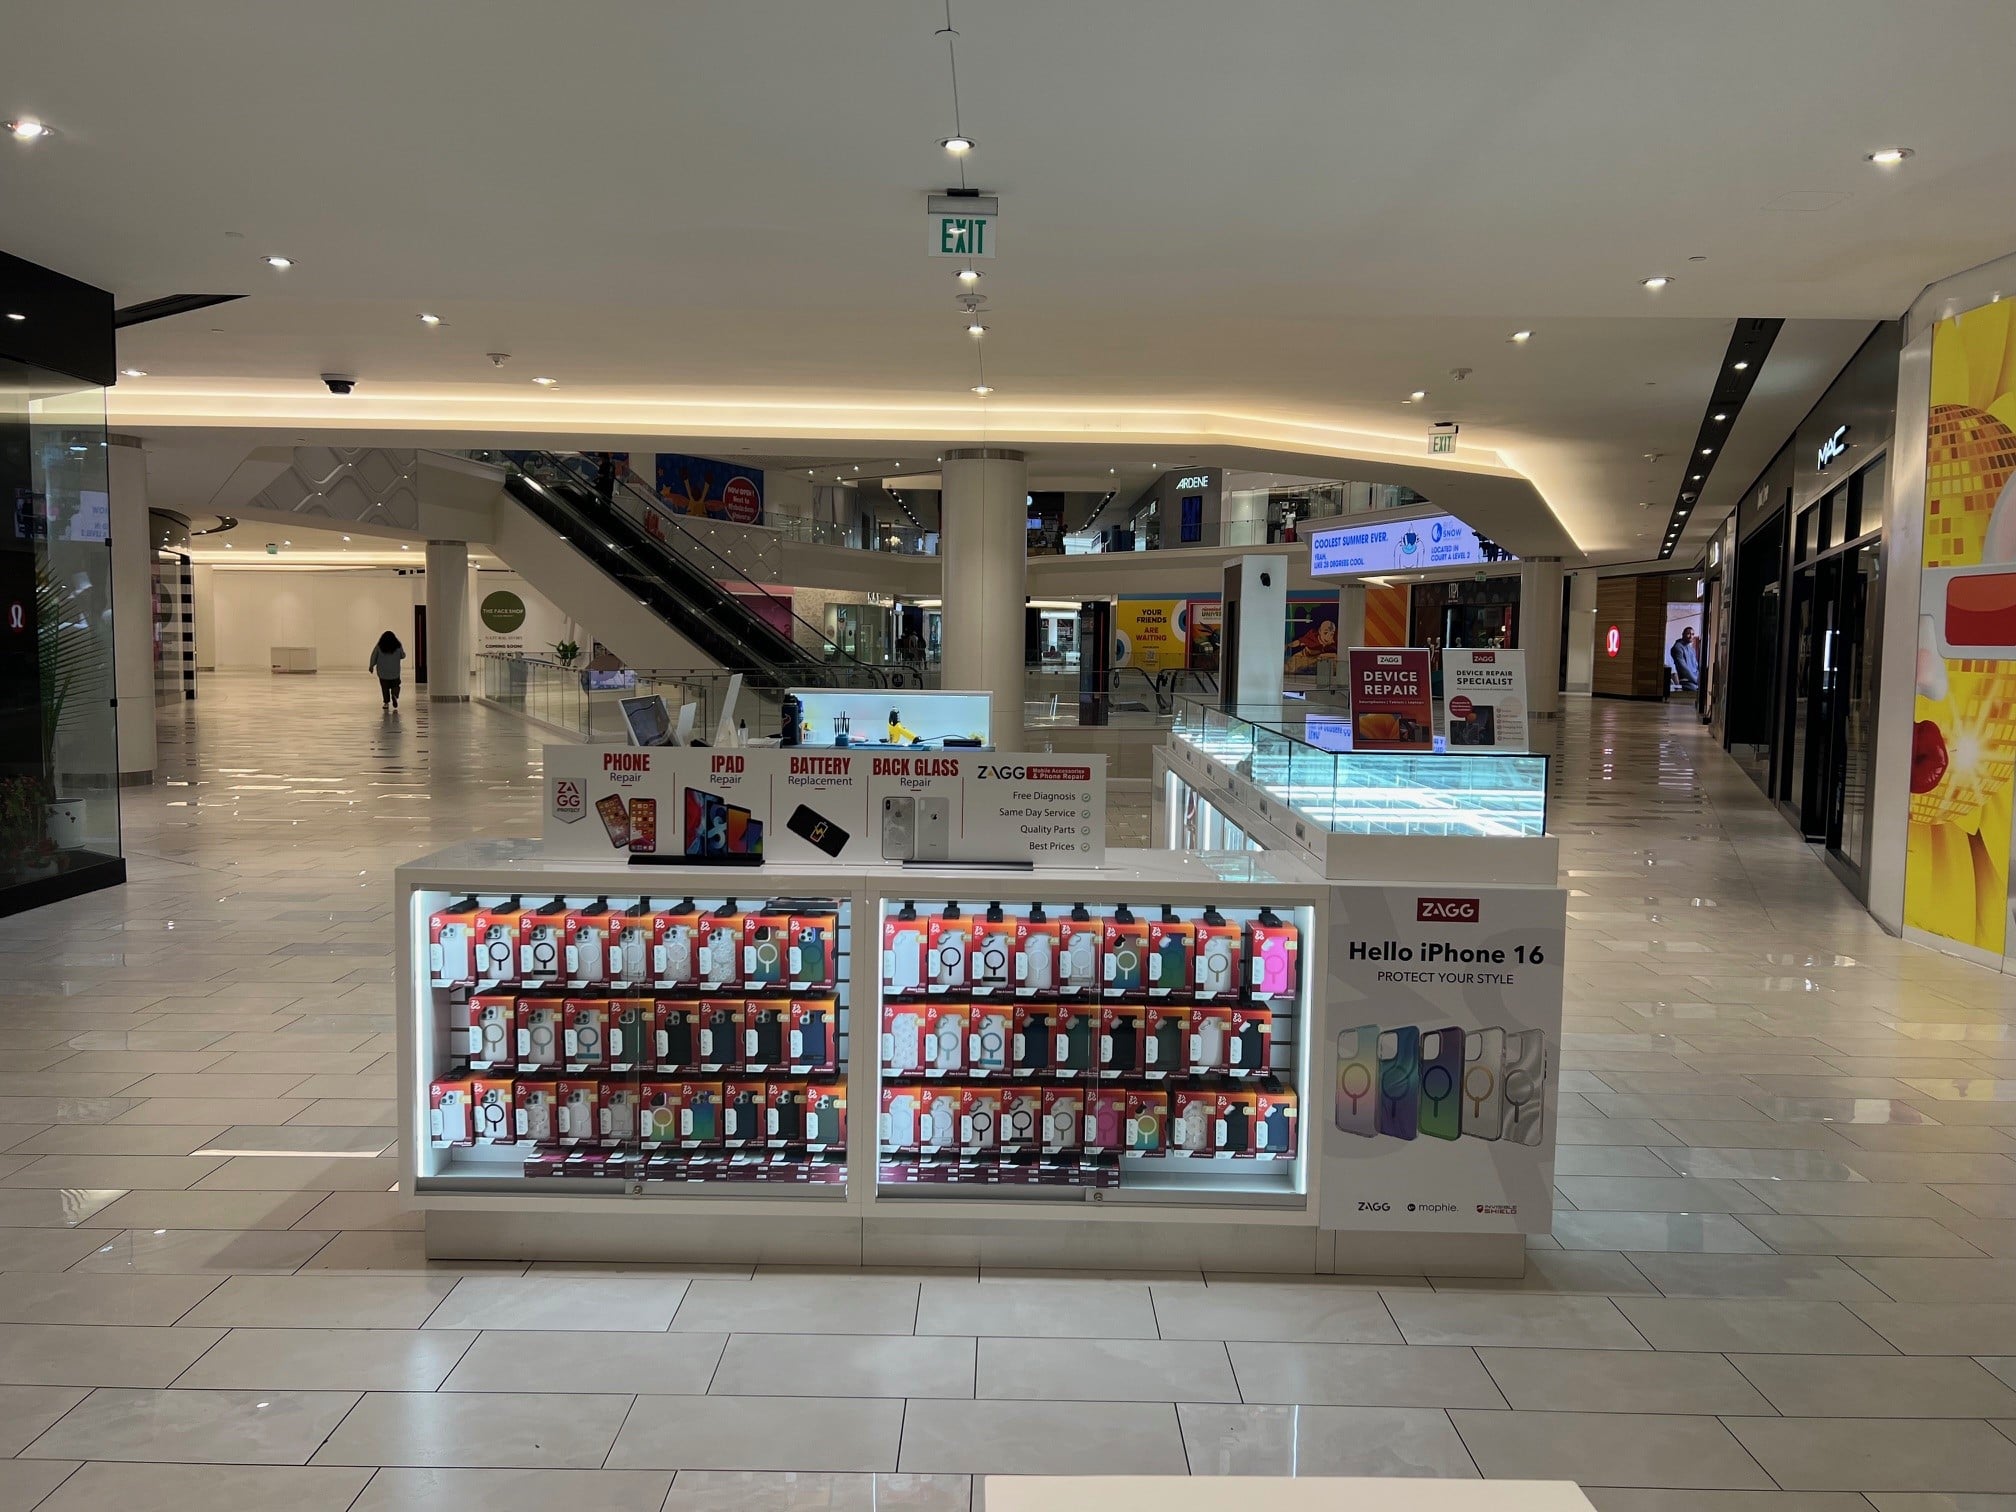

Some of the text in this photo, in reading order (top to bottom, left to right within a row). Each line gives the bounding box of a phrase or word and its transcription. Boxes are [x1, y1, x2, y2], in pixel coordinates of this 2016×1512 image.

[941, 218, 987, 254] EXIT
[1433, 435, 1453, 452] EXIT
[1176, 475, 1209, 490] ARDENE
[1442, 528, 1462, 538] SNOW
[1314, 536, 1341, 549] COOLEST
[1342, 534, 1369, 546] SUMMER
[1136, 616, 1167, 624] FRIENDS
[1363, 671, 1418, 682] DEVICE
[1456, 677, 1513, 686] SPECIALIST
[1364, 684, 1418, 695] REPAIR
[603, 753, 650, 772] PHONE
[711, 755, 745, 774] IPAD
[790, 756, 851, 775] BATTERY
[872, 758, 959, 777] BACK GLASS
[610, 772, 641, 784] Repair
[977, 765, 1025, 780] ZAGG
[1064, 773, 1085, 781] Repair
[710, 774, 742, 785] Repair
[788, 776, 853, 787] Replacement
[900, 777, 932, 788] Repair
[556, 795, 580, 807] GG
[1013, 791, 1076, 802] Free Diagnosis
[999, 808, 1076, 818] Same Day Service
[1020, 825, 1075, 835] Quality Parts
[1029, 842, 1075, 851] Best Prices
[1422, 902, 1475, 918] ZAGG
[1349, 941, 1544, 965] Hello iPhone 16
[1377, 971, 1514, 984] PROTECT YOUR STYLE
[1358, 1202, 1391, 1211] ZAGG
